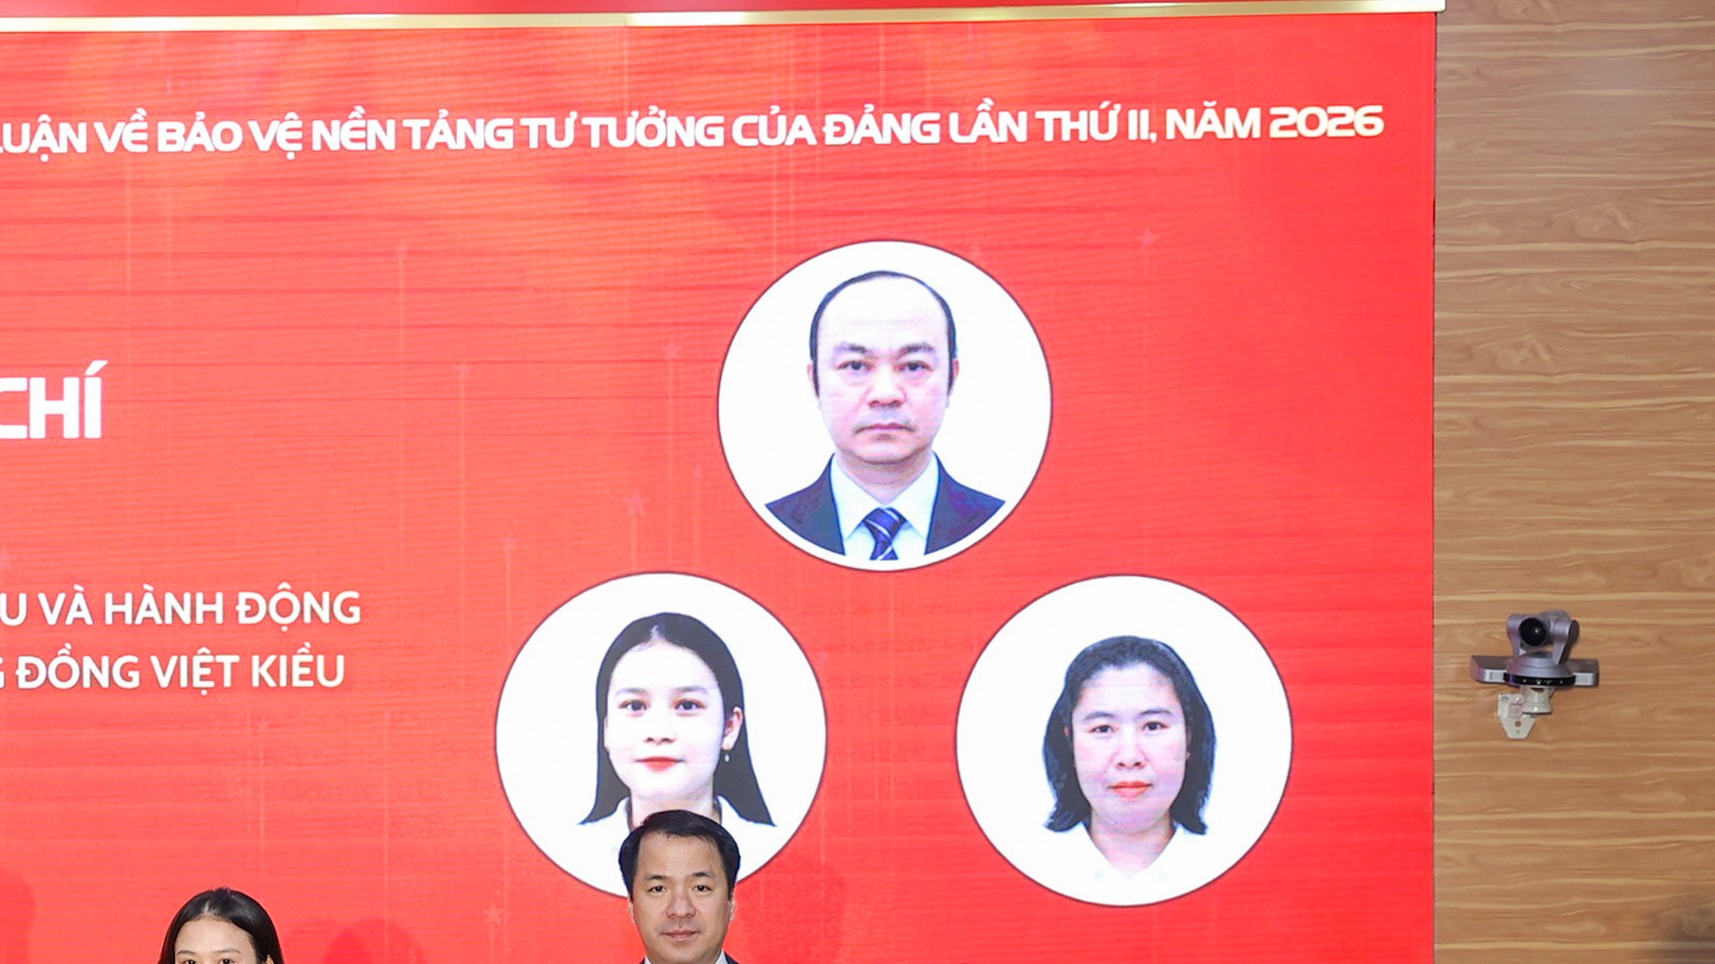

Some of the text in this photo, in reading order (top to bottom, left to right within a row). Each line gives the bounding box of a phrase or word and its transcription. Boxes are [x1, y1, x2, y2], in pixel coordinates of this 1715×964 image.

[93, 107, 149, 153] VỀ
[157, 110, 244, 153] BẢO
[247, 111, 303, 160] VỆ
[311, 105, 396, 151] NỀN
[402, 108, 514, 151] TẢNG
[519, 110, 578, 150] TƯ
[581, 104, 725, 149] TƯỞNG
[731, 104, 818, 147] CỦA
[821, 103, 941, 146] ĐẢNG
[949, 98, 1028, 144] LẦN
[1034, 100, 1122, 142] THỨ
[1128, 109, 1157, 144] II,
[1166, 100, 1261, 140] NĂM
[1269, 105, 1385, 138] 2026
[37, 583, 94, 626] VÀ
[104, 583, 224, 625] HÀNH
[235, 581, 361, 632] ĐỘNG
[15, 642, 140, 689] ĐỒNG
[150, 646, 241, 696] VIỆT
[251, 641, 345, 688] KIỀU
